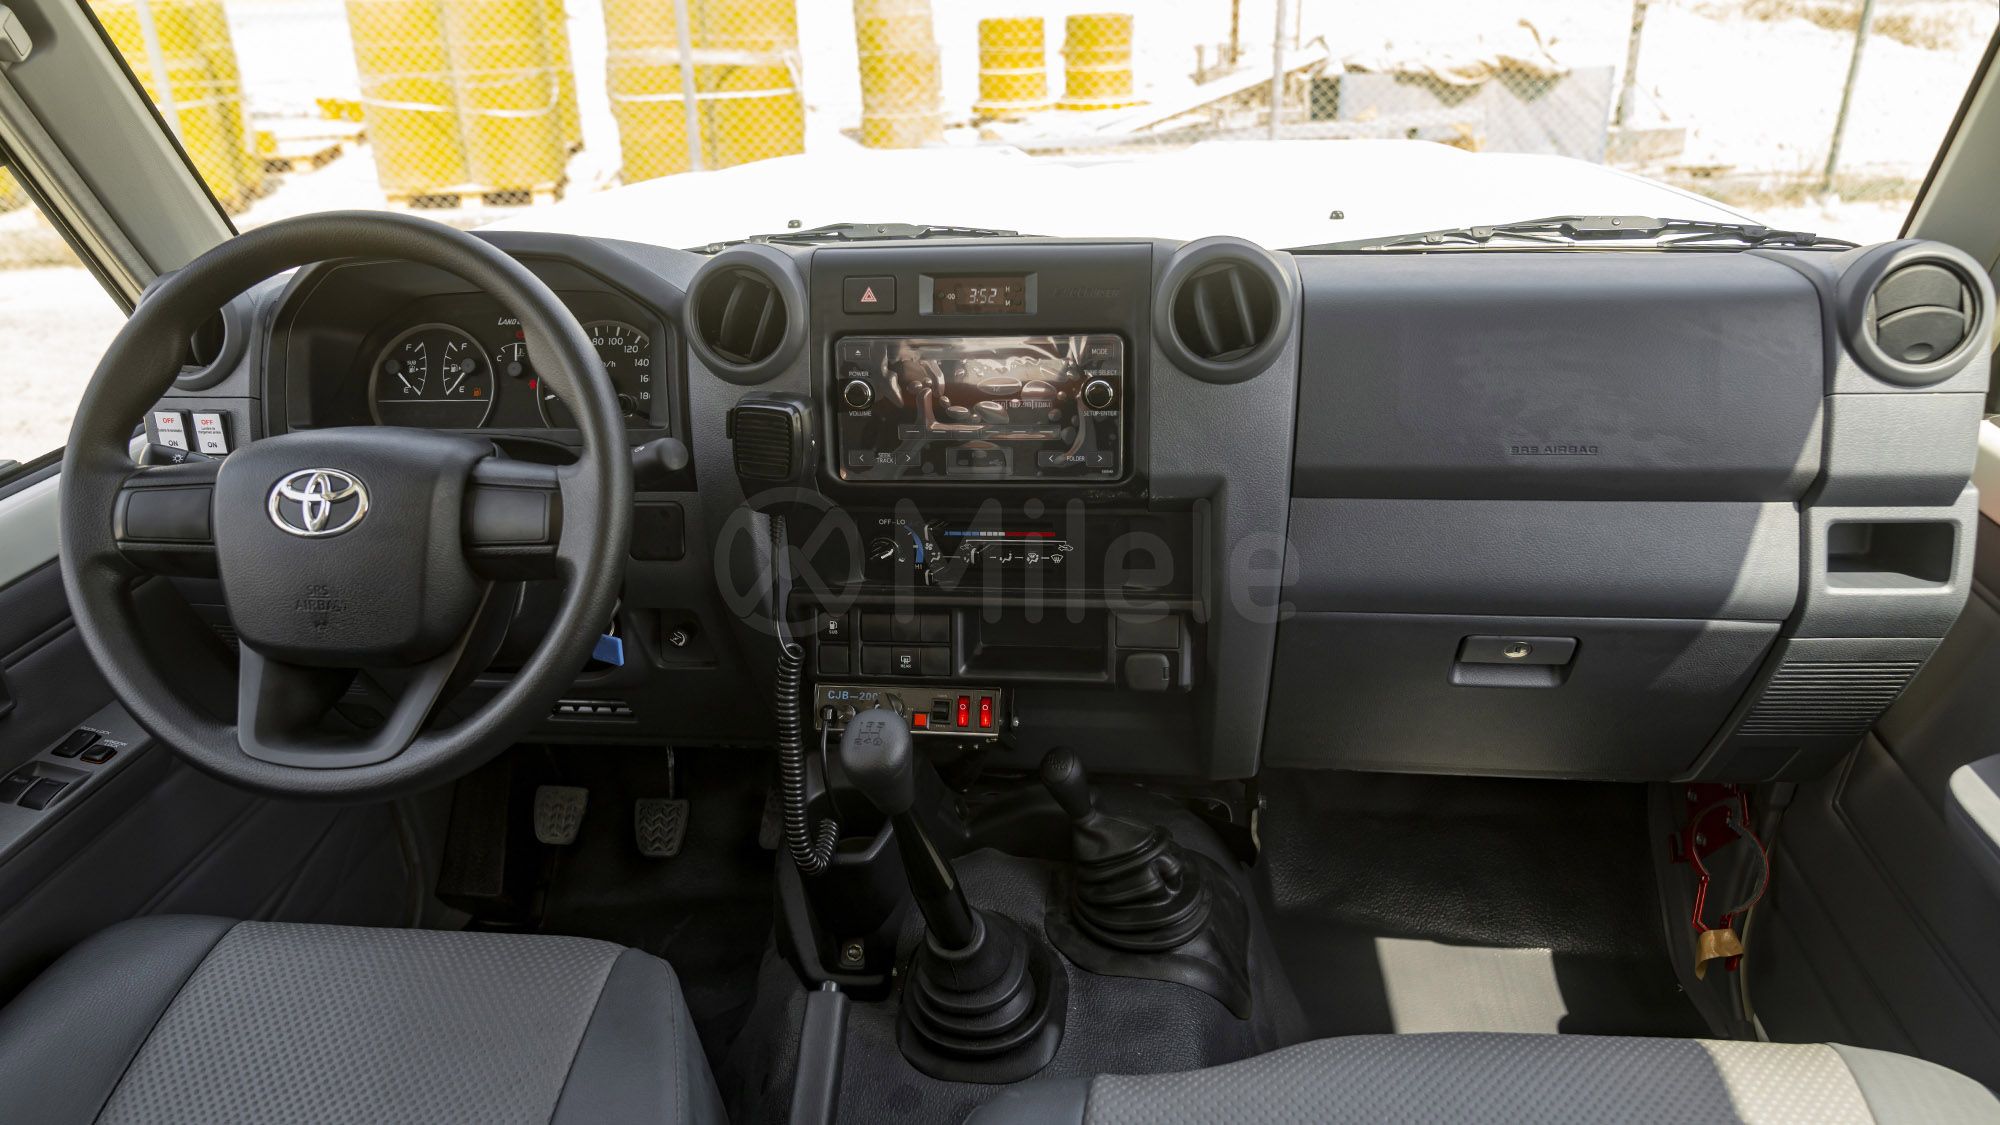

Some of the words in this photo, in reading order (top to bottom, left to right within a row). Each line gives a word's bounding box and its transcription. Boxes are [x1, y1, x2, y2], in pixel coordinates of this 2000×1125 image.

[968, 288, 997, 304] 3:52
[497, 316, 517, 325] LAND
[592, 337, 604, 346] 80
[608, 337, 624, 346] 100
[405, 343, 413, 351] F
[460, 342, 468, 351] F
[624, 345, 639, 354] 120
[634, 358, 650, 367] 140
[640, 375, 650, 383] 16
[458, 385, 465, 393] E
[168, 439, 179, 447] ON
[207, 441, 218, 449] ON
